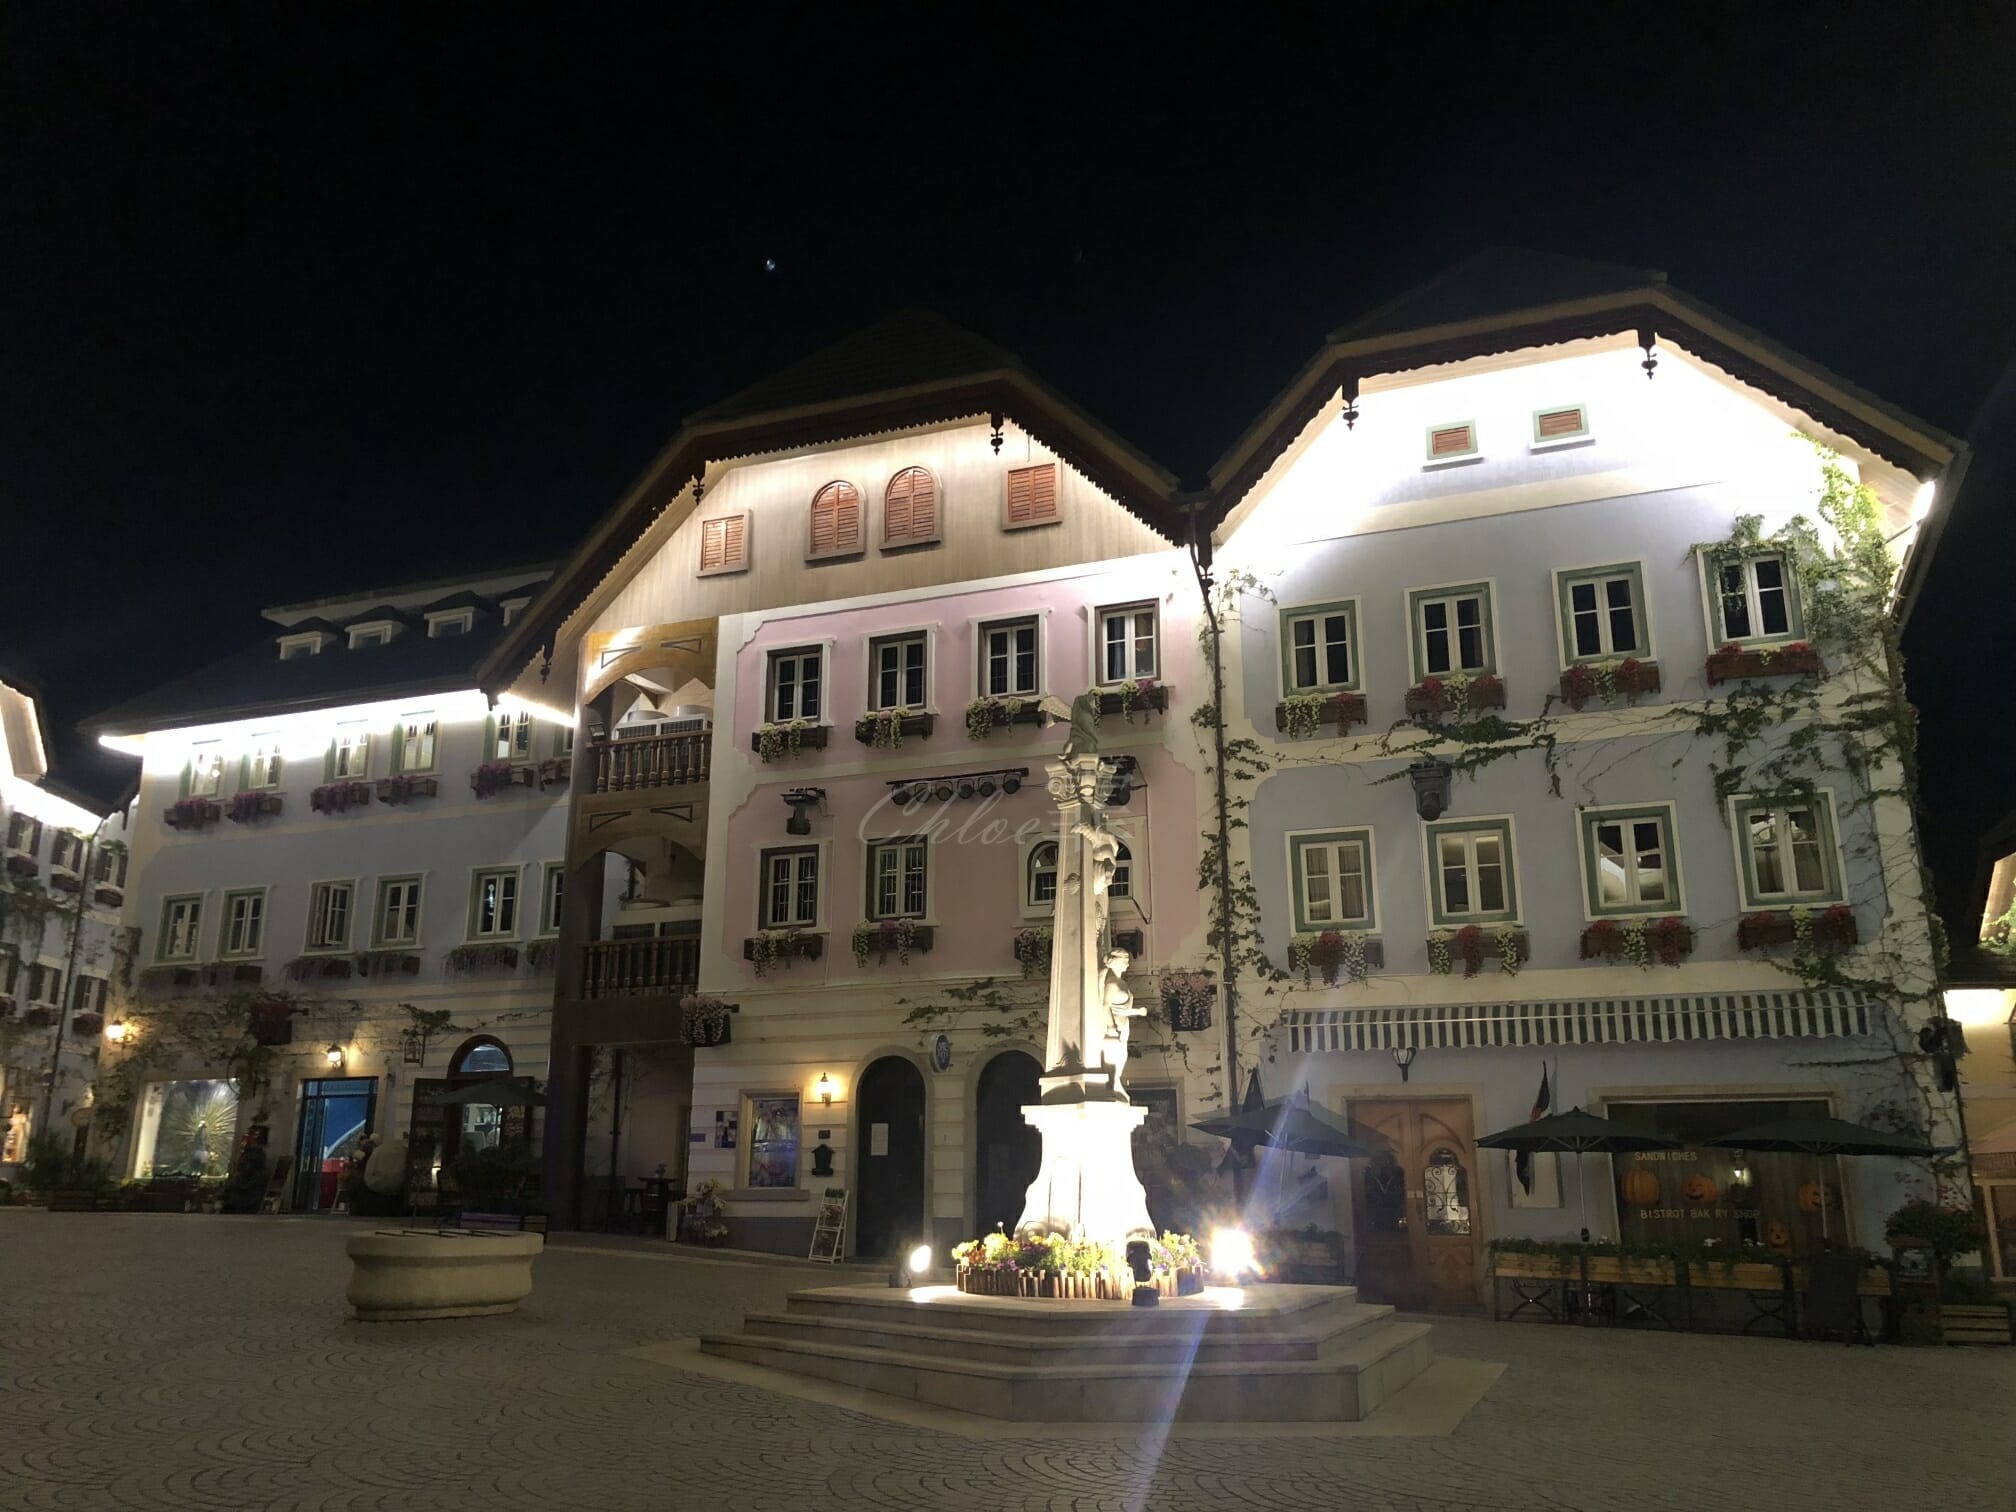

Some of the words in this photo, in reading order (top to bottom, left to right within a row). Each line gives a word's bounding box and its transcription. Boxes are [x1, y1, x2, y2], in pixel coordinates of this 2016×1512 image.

[1634, 1151, 1698, 1161] SANDWICHES
[1640, 1208, 1685, 1219] BISTROT
[1689, 1207, 1728, 1218] BAKRY
